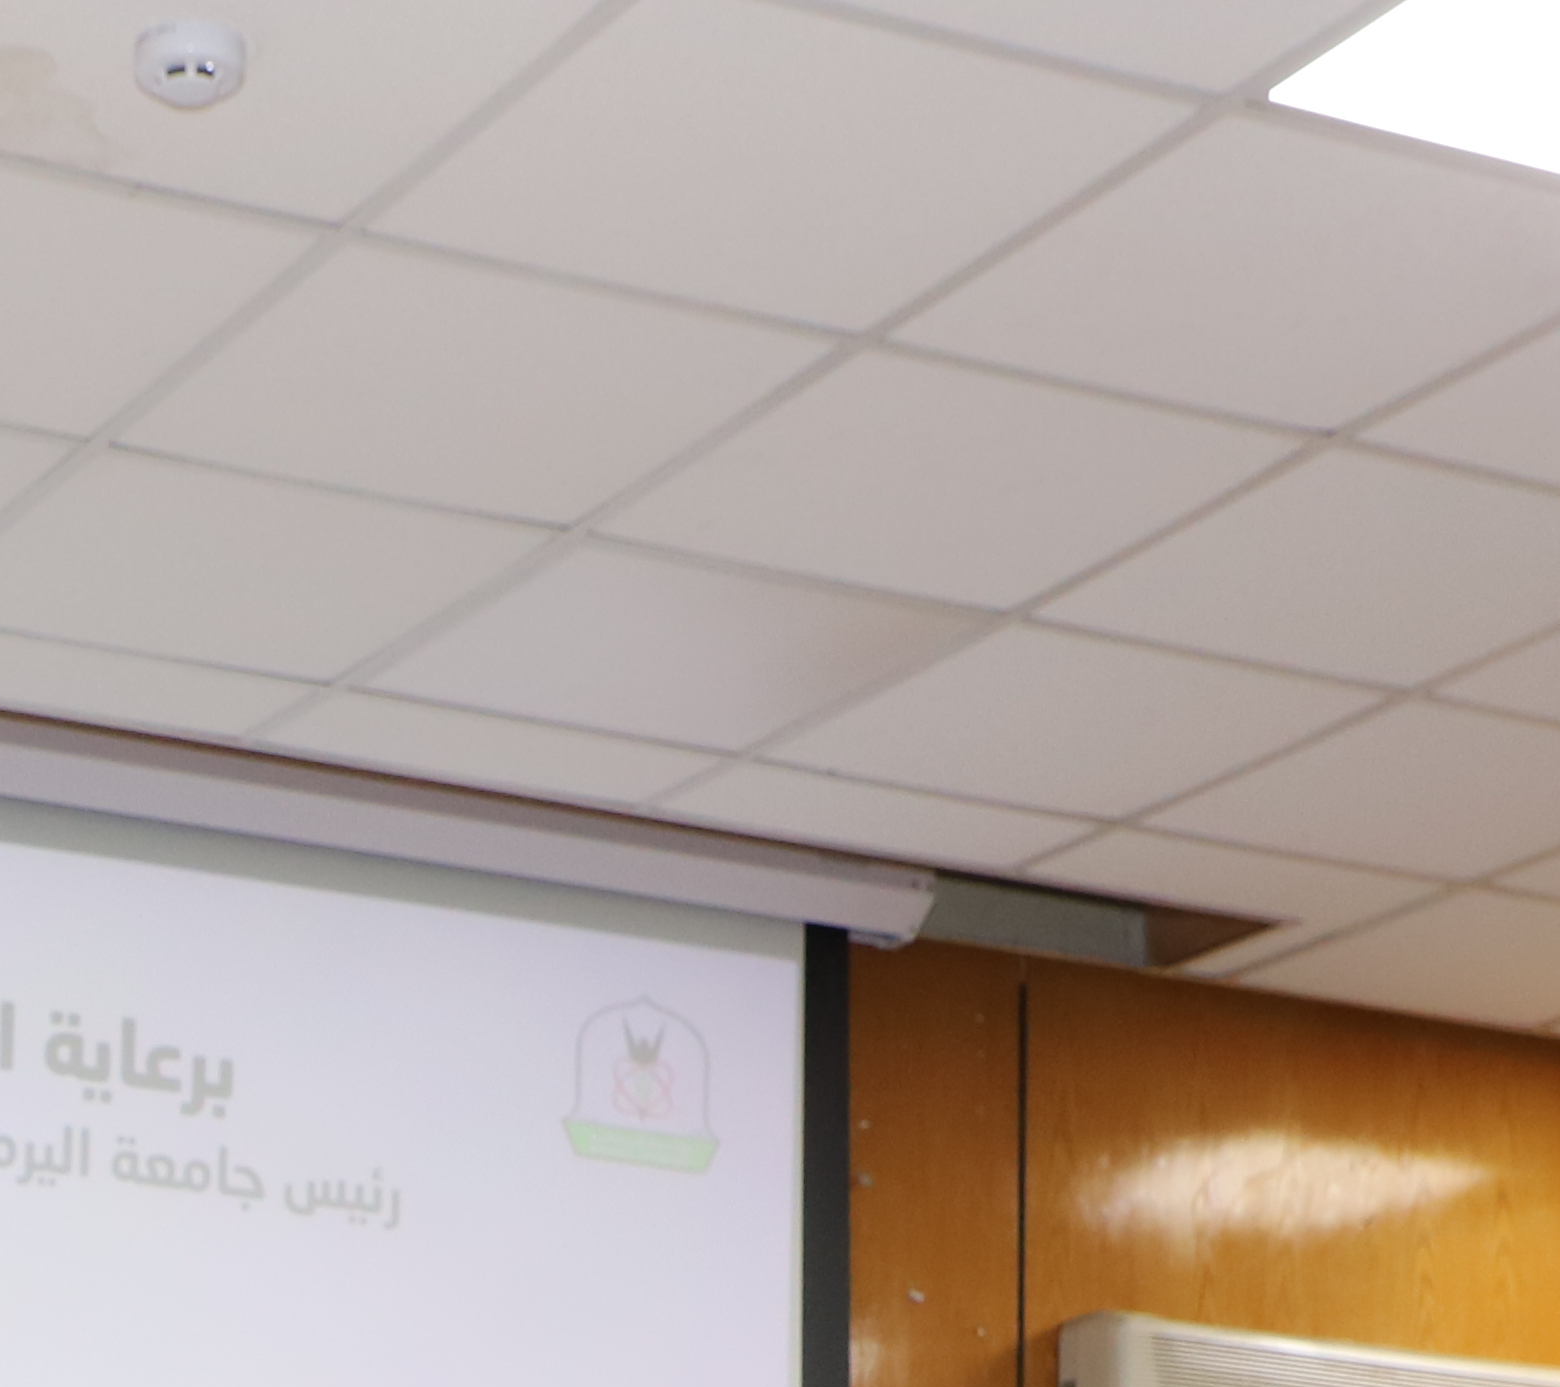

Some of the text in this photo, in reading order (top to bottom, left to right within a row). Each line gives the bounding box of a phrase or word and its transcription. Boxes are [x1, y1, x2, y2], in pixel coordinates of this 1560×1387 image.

[43, 1009, 236, 1119] برعاية
[109, 1138, 266, 1212] جامعة
[282, 1176, 403, 1232] رئيس
